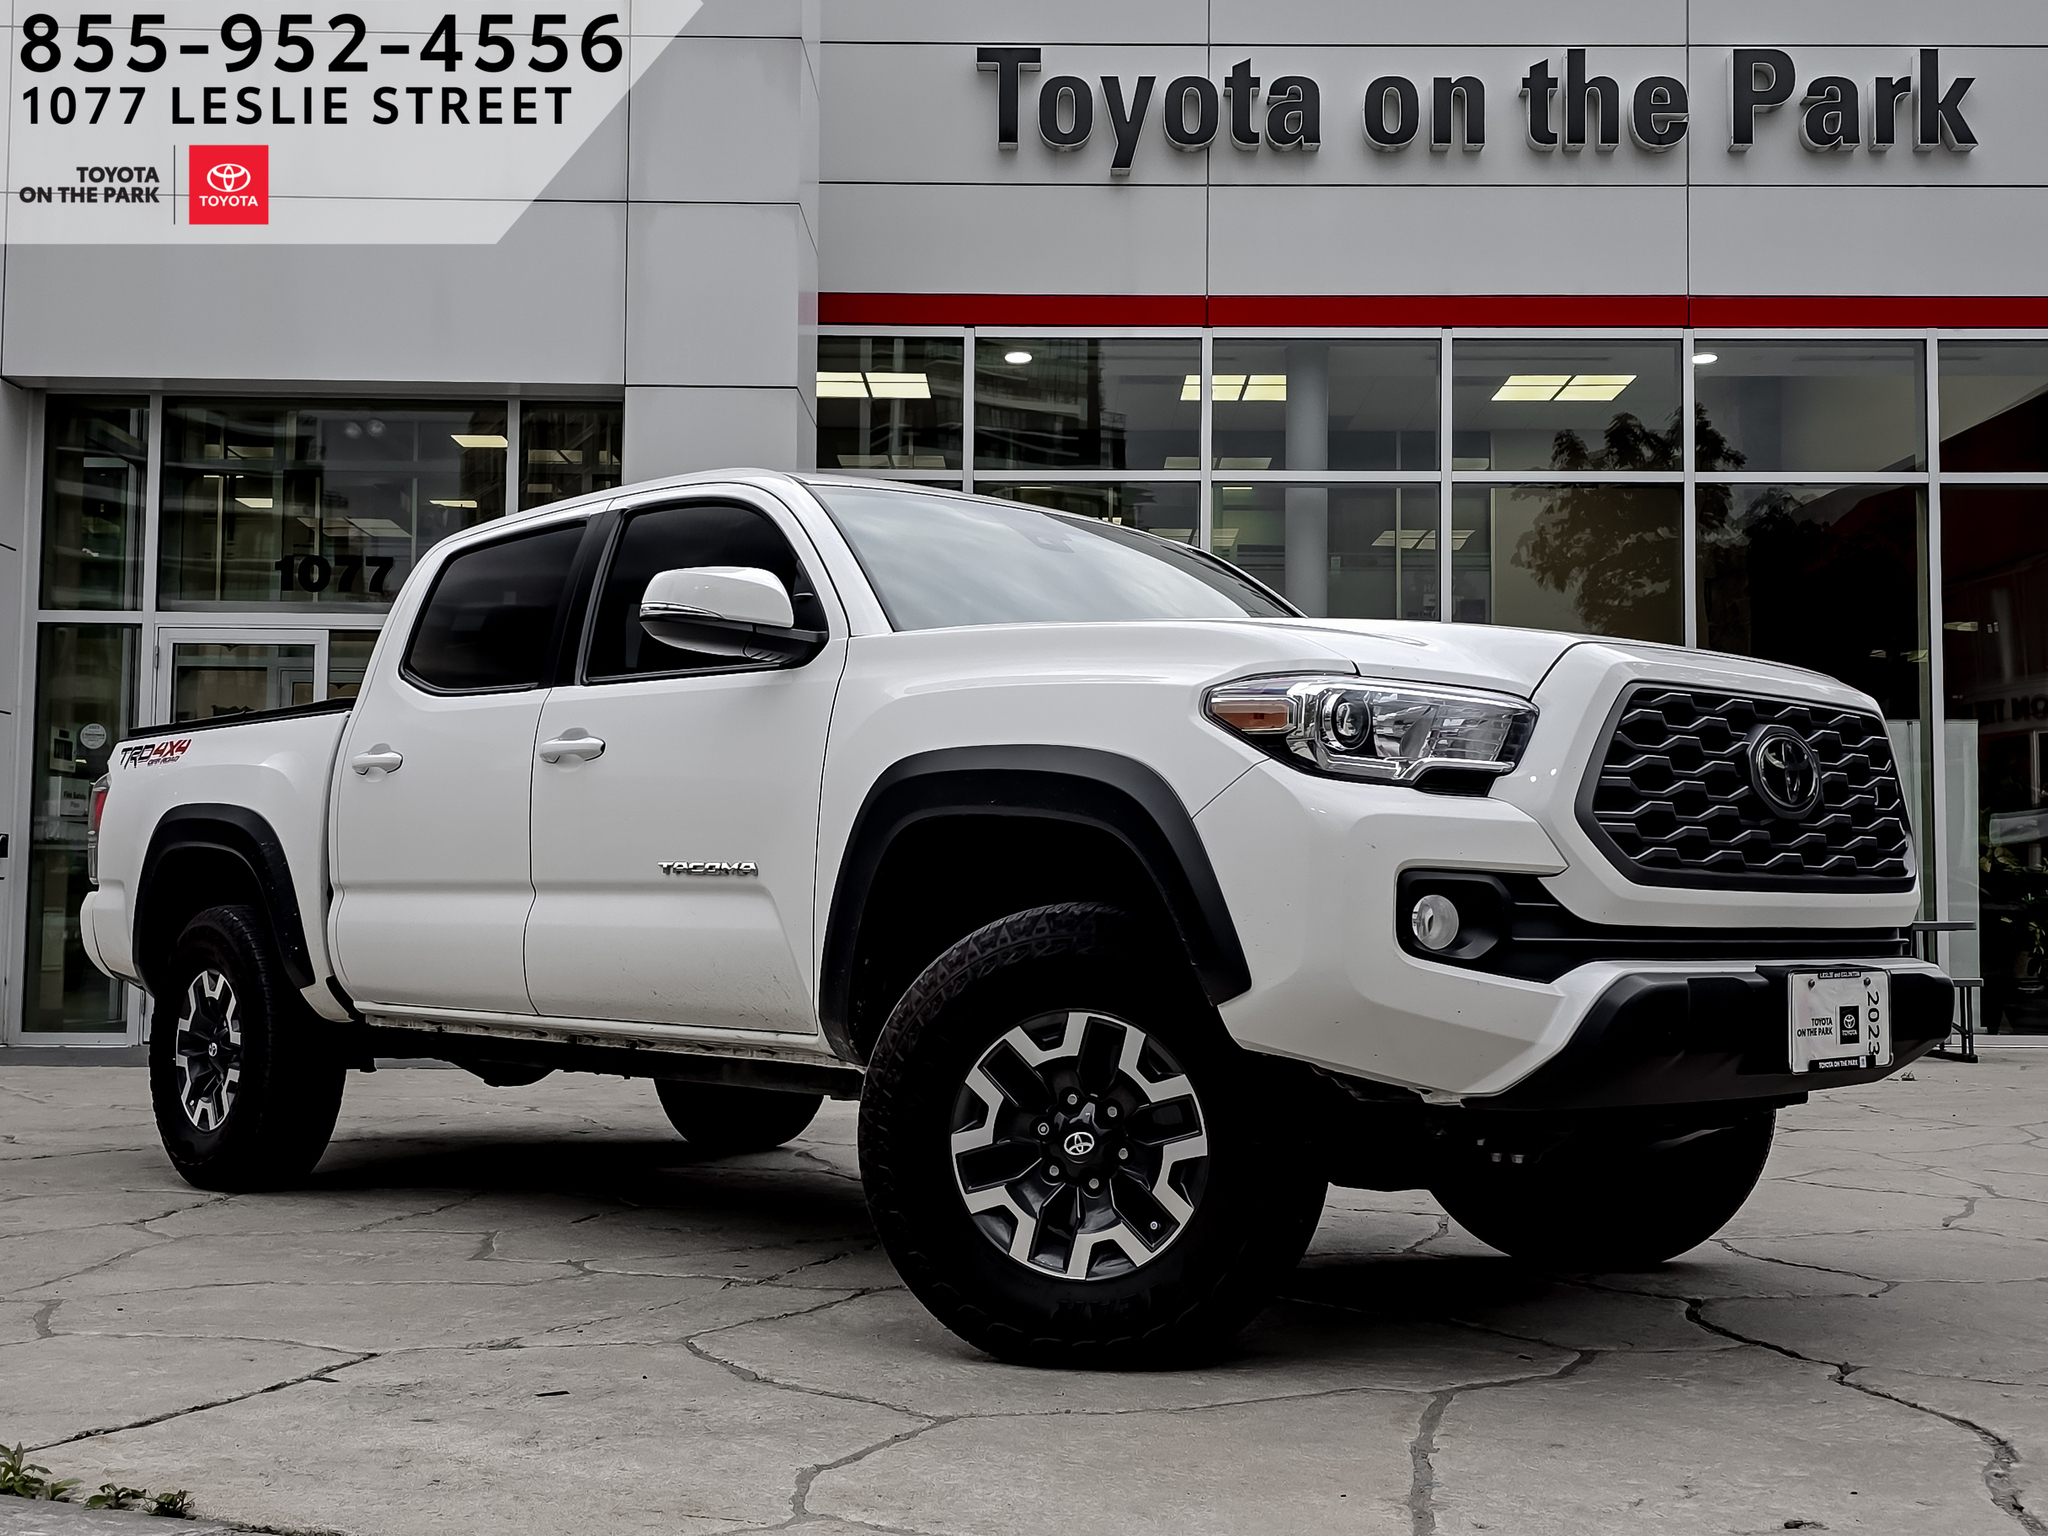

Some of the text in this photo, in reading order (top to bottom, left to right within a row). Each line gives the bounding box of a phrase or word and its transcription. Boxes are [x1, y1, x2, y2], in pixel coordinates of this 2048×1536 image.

[976, 46, 1978, 177] Toyota on the Park
[274, 553, 394, 593] 1077
[119, 739, 192, 770] TRD 4X4
[657, 861, 759, 876] TACOMA
[1797, 1026, 1833, 1037] ON THE PARK
[1811, 1017, 1833, 1026] TOYOTA
[1867, 991, 1880, 1056] 2023
